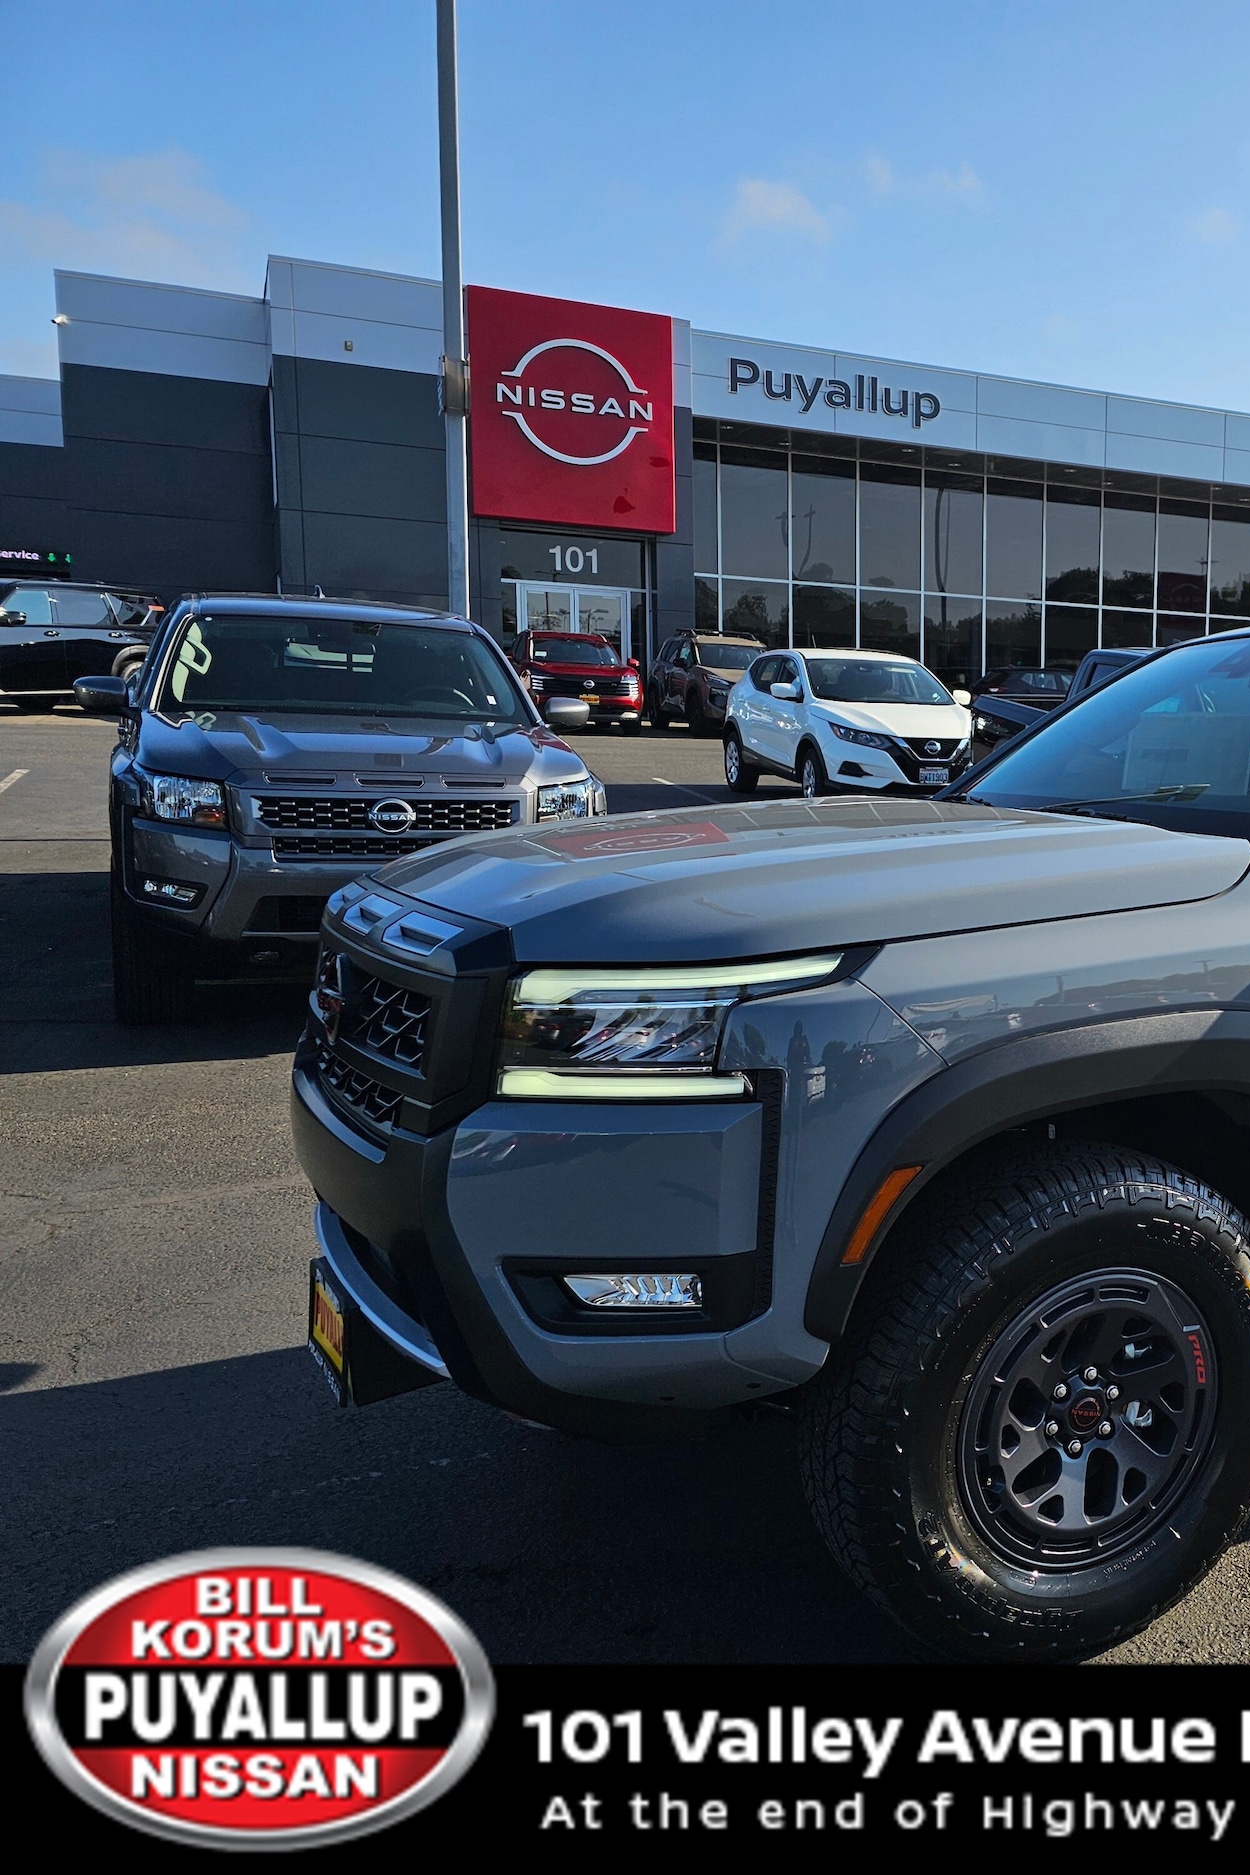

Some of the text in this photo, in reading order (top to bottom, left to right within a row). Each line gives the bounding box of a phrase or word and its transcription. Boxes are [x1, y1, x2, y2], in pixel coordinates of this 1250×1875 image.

[496, 382, 654, 422] NISSAN
[728, 357, 941, 429] Puyallup
[0, 550, 40, 561] ervice
[548, 545, 599, 574] 101
[368, 812, 416, 821] NISSAN
[1187, 1334, 1206, 1384] PRO
[1071, 1408, 1102, 1417] NISSAN
